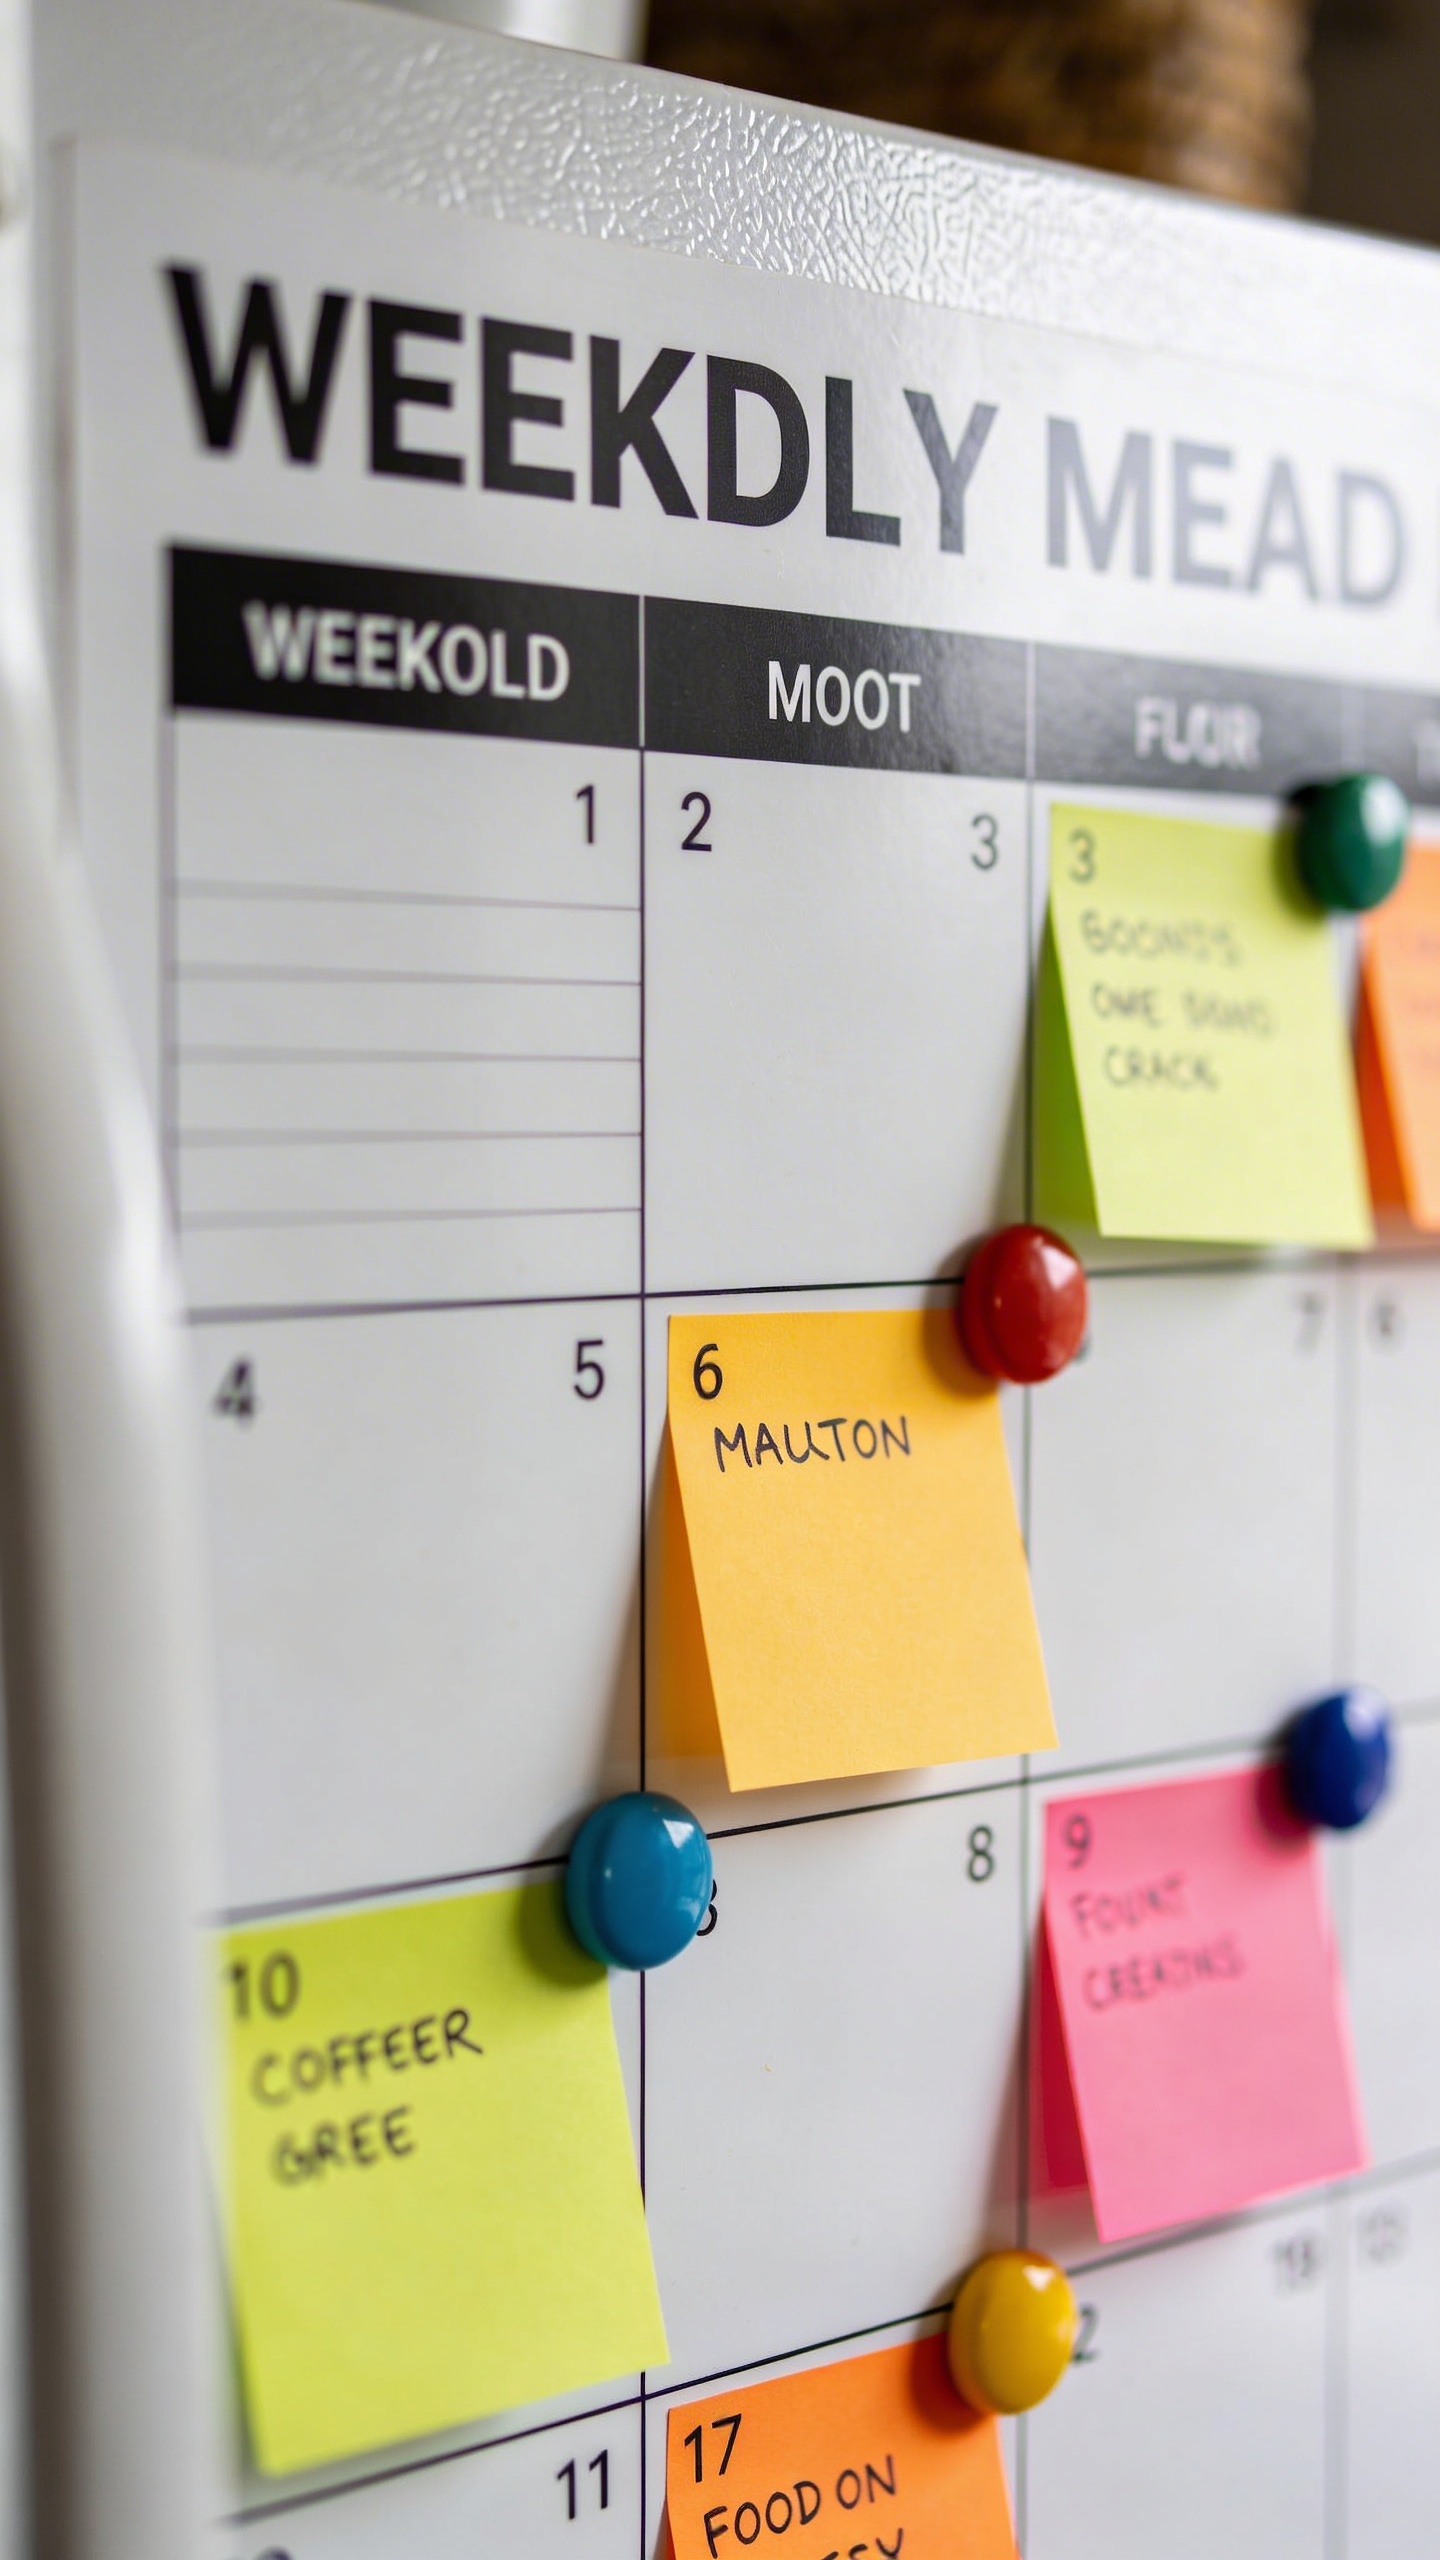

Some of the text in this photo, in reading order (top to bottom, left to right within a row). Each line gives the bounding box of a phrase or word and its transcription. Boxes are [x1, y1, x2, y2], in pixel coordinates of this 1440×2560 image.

[163, 258, 998, 555] WEEKDLY
[1046, 415, 1408, 609] MEAD
[242, 600, 570, 701] WEEKOLD
[768, 661, 921, 733] MOOT
[576, 784, 595, 845] 1
[680, 791, 712, 852] 2
[970, 815, 999, 871] 3
[1069, 828, 1096, 884] 3
[214, 1356, 257, 1427] 4
[574, 1339, 605, 1401] 5
[693, 1343, 723, 1401] 6
[967, 1826, 995, 1882] 8
[1064, 1814, 1091, 1870] 9
[225, 1953, 300, 2020] 10
[251, 2008, 484, 2108] COFFEER
[684, 2413, 742, 2484] 17
[556, 2449, 609, 2521] 11
[704, 2481, 821, 2559] FOOD
[836, 2454, 896, 2510] ON
